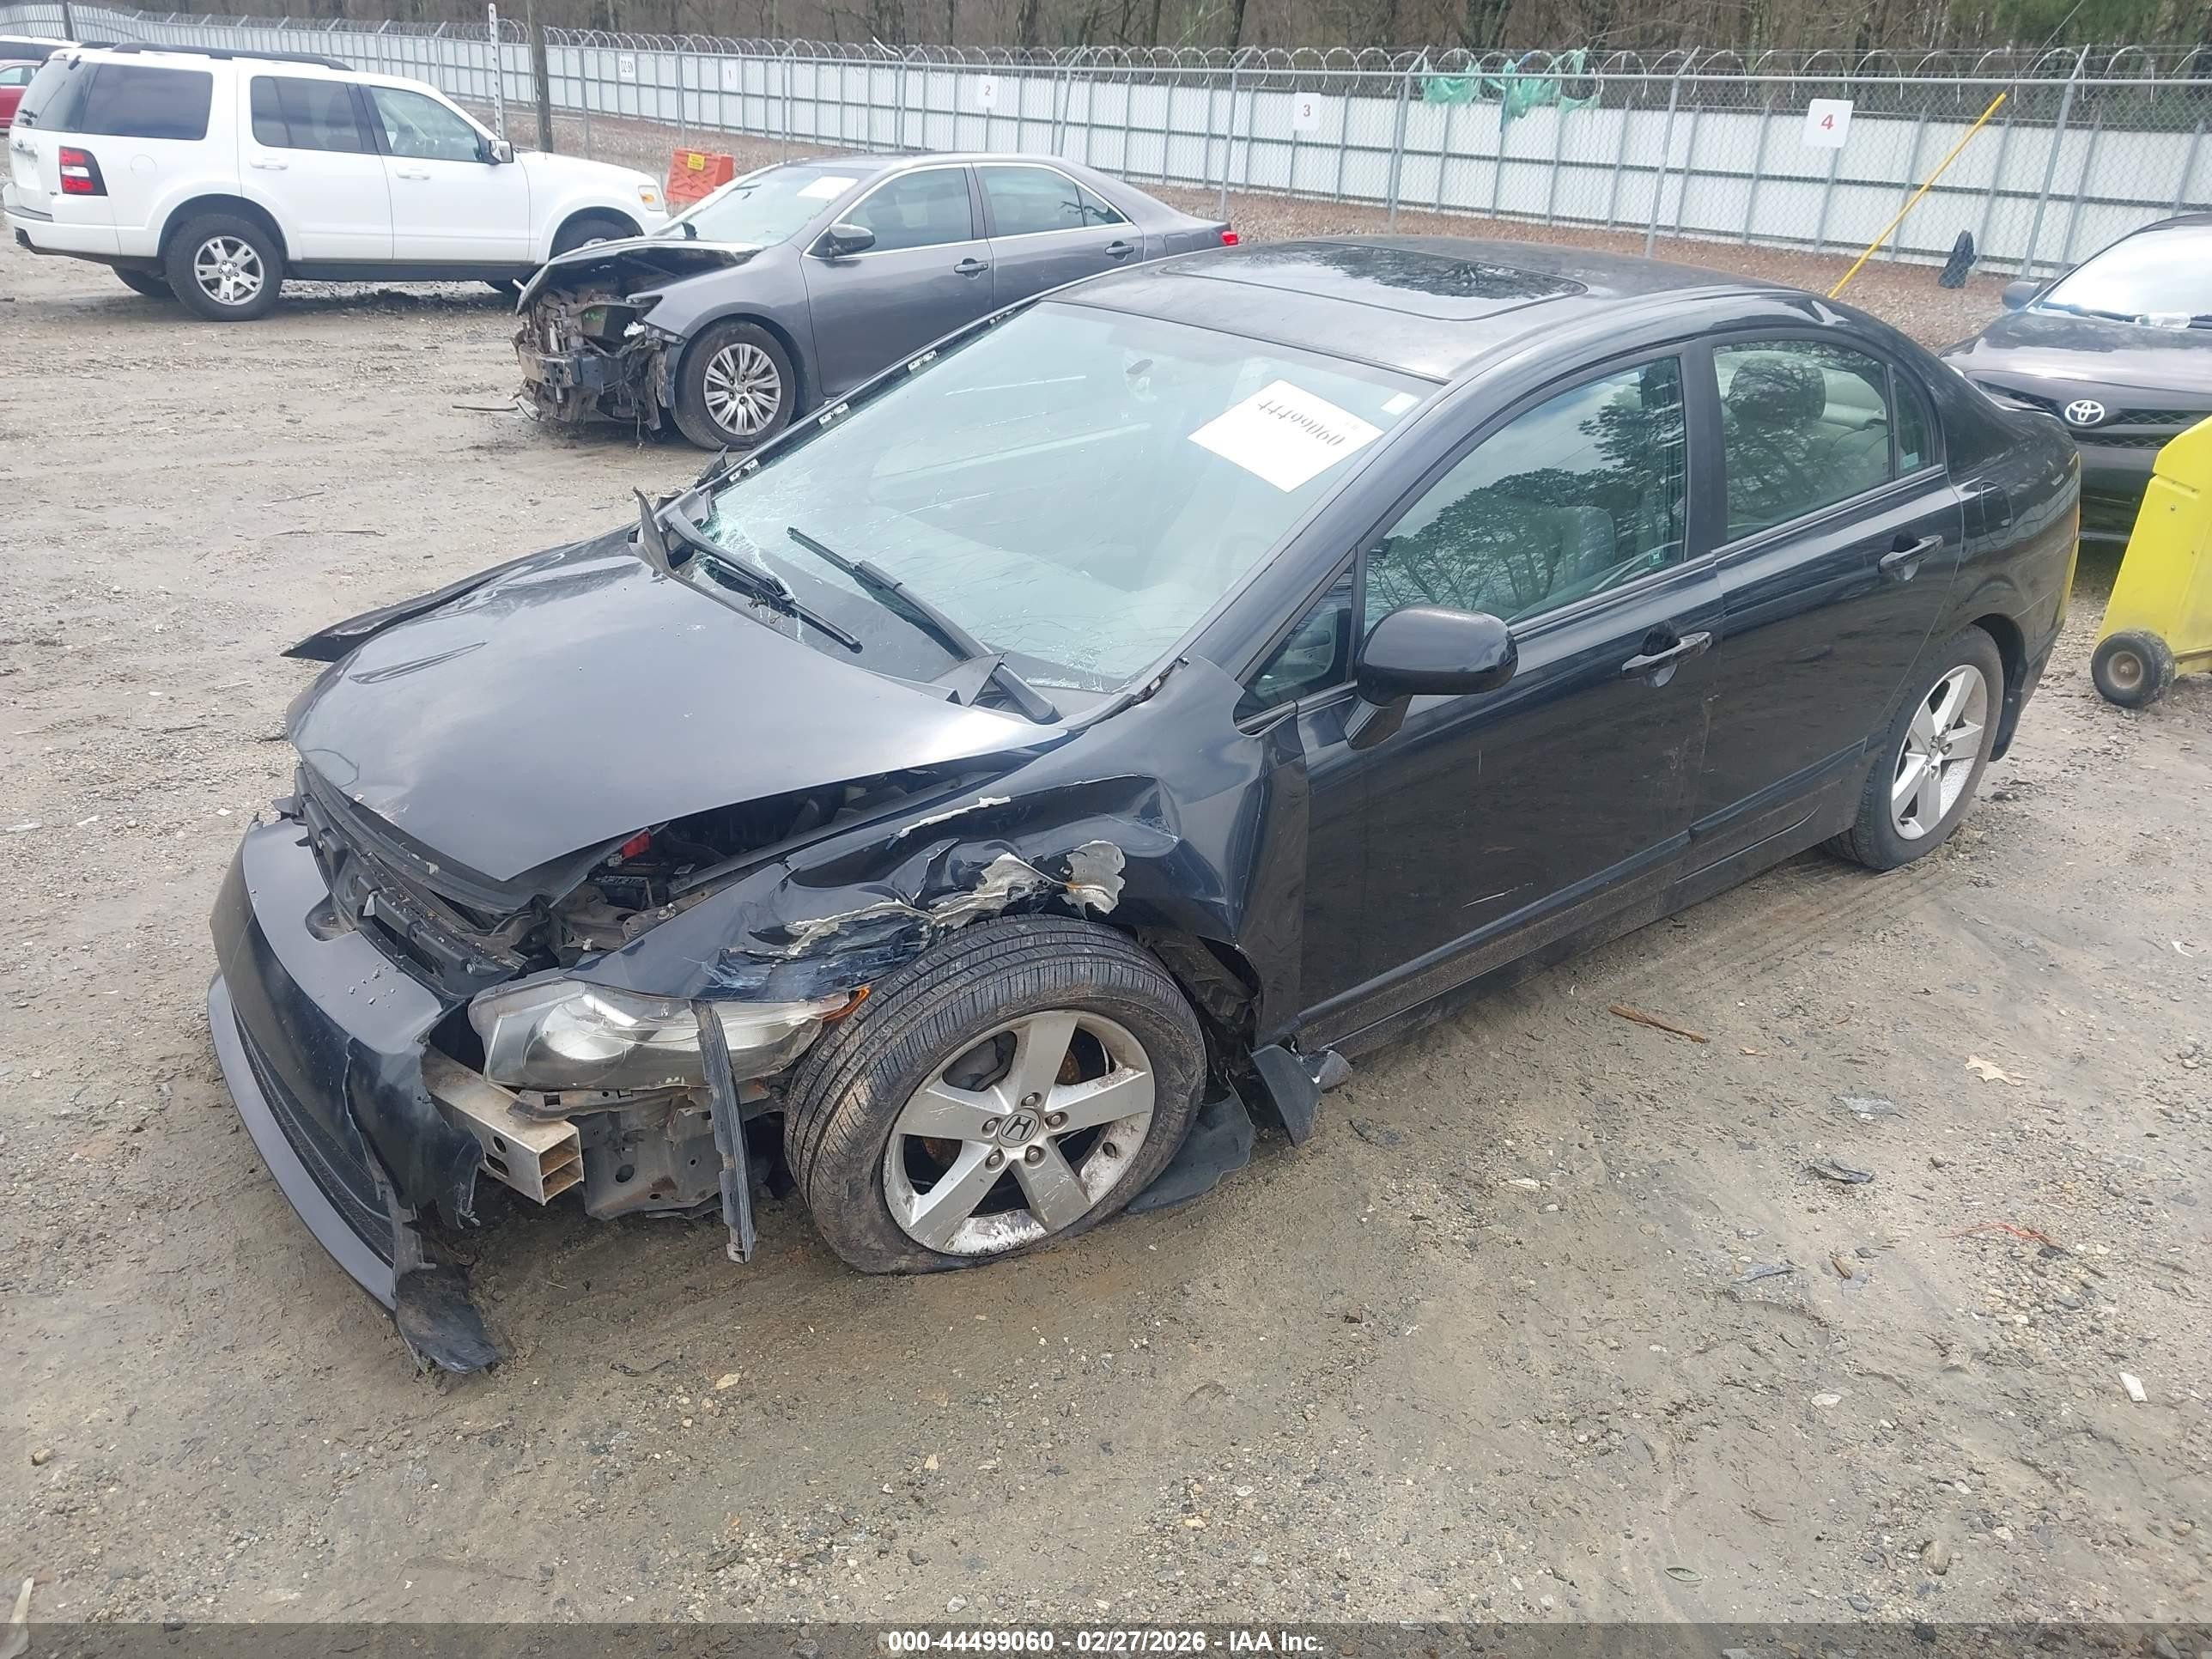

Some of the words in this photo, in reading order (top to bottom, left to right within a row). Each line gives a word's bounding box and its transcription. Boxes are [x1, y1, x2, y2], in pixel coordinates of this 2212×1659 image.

[985, 85, 991, 96] 2
[1304, 104, 1311, 117] 3
[1820, 114, 1834, 130] 4
[1257, 400, 1346, 446] 44499060
